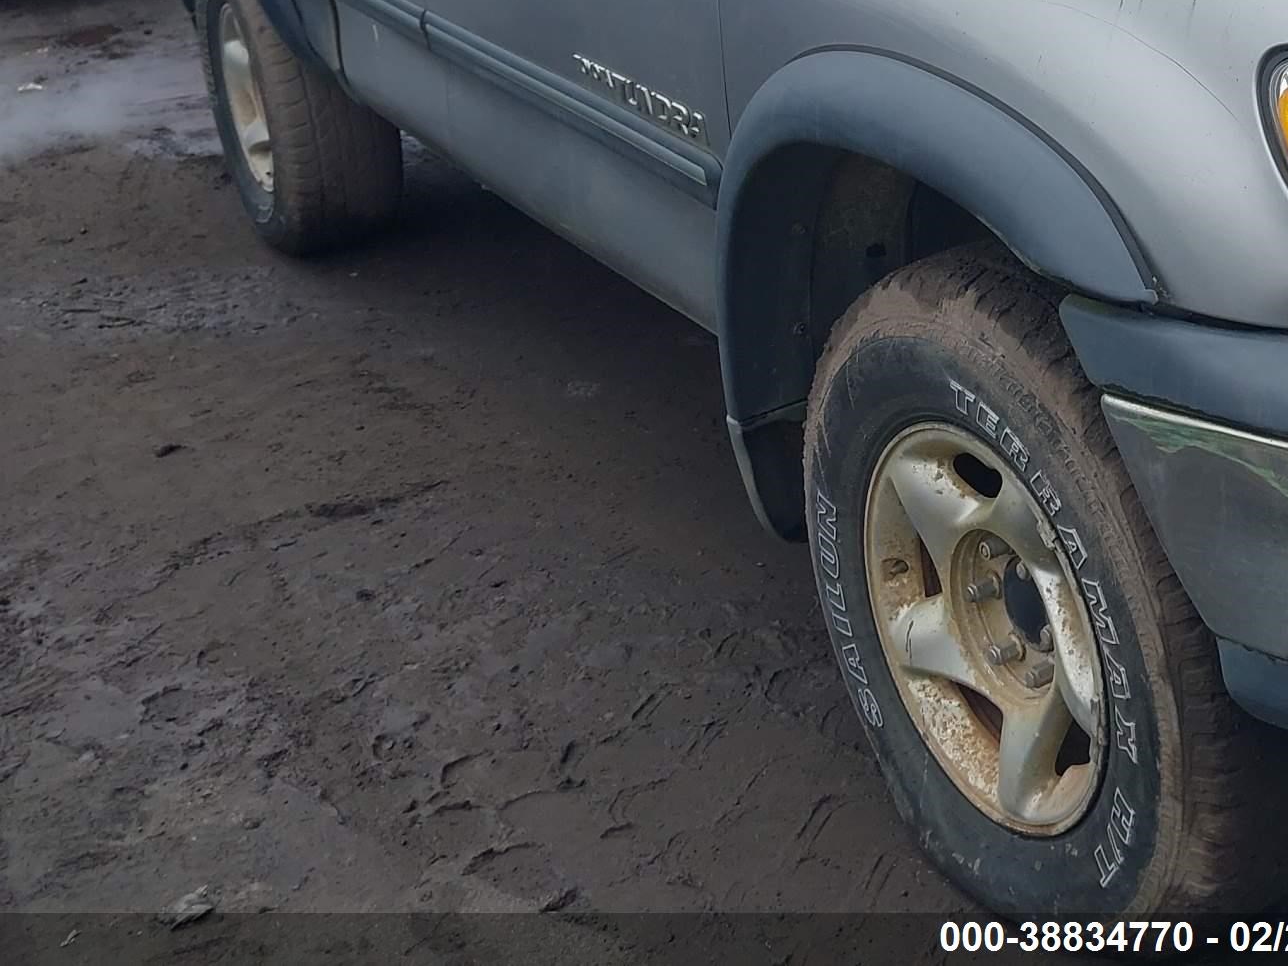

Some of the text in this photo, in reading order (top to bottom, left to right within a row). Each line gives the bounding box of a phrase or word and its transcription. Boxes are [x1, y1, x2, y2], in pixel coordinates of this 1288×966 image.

[815, 489, 885, 729] SAILUN
[949, 378, 1139, 889] TERRAMAX H/T
